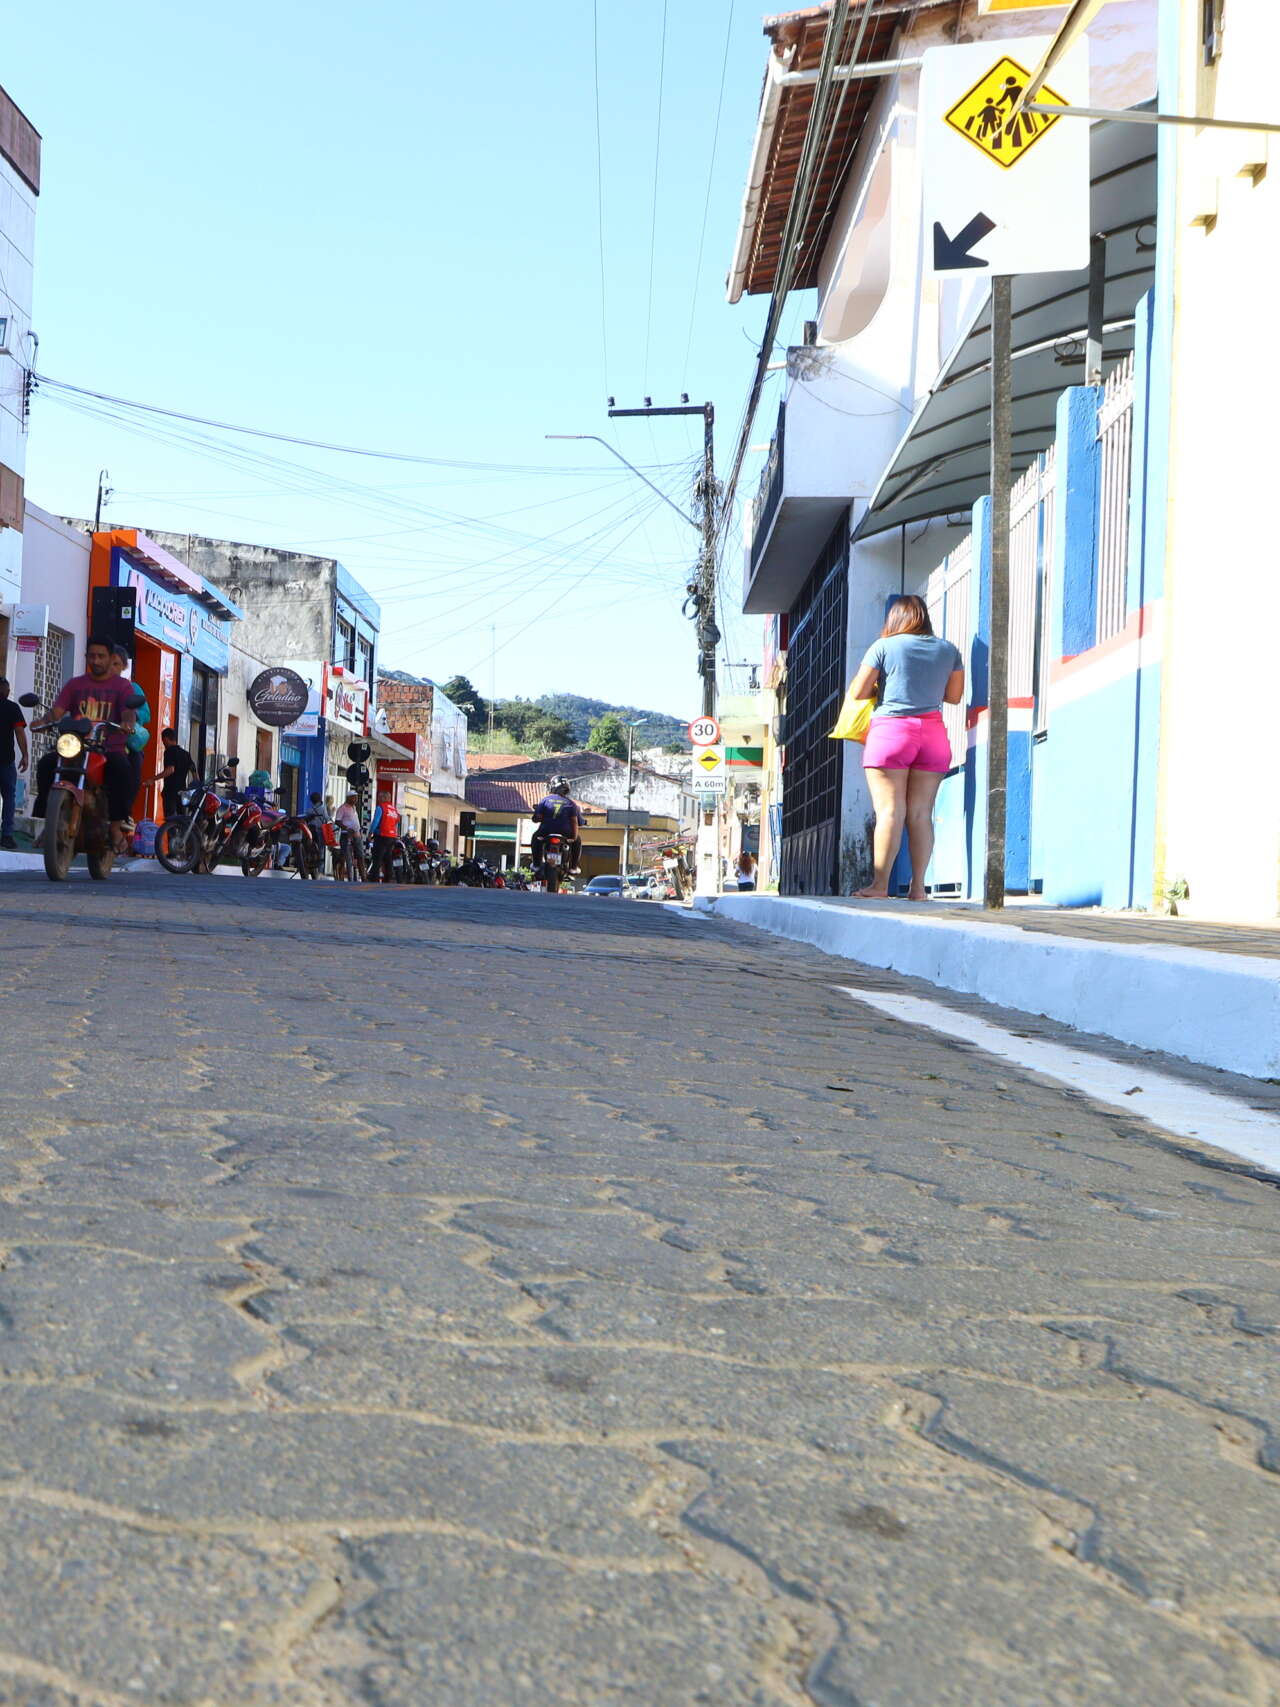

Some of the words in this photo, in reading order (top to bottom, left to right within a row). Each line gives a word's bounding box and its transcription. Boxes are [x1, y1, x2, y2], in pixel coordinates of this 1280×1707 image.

[694, 723, 714, 736] 30
[694, 780, 701, 788] A
[704, 780, 724, 789] 60m
